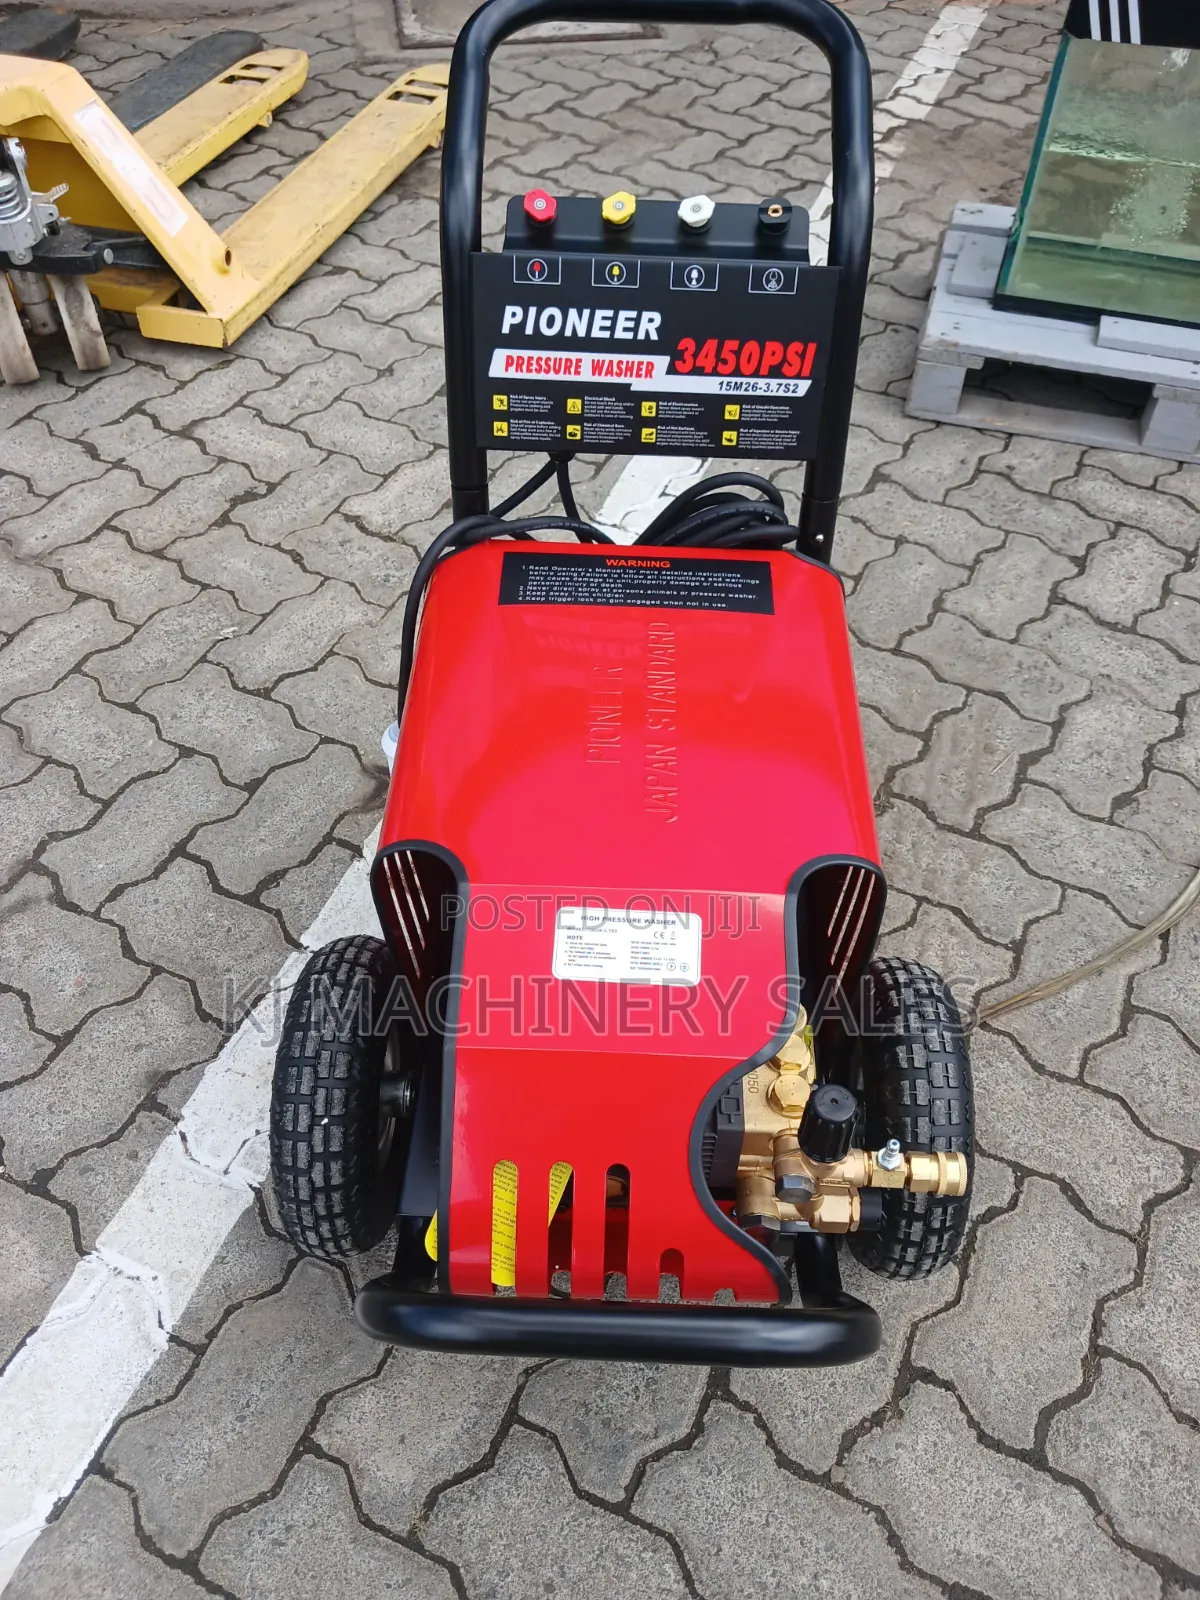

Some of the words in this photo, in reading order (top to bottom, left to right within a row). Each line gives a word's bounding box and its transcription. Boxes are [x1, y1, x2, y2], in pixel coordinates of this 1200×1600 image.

[501, 305, 662, 341] PIONEER
[504, 354, 583, 377] PRESSURE
[591, 359, 655, 379] WASHER
[674, 338, 817, 377] 3450PSI
[717, 380, 800, 394] 15M26-3.7S2
[606, 559, 671, 568] WARNING
[646, 622, 677, 731] STANDARD
[643, 744, 679, 824] JAPAN
[602, 916, 642, 924] PRESSURE
[644, 918, 677, 926] WASHER
